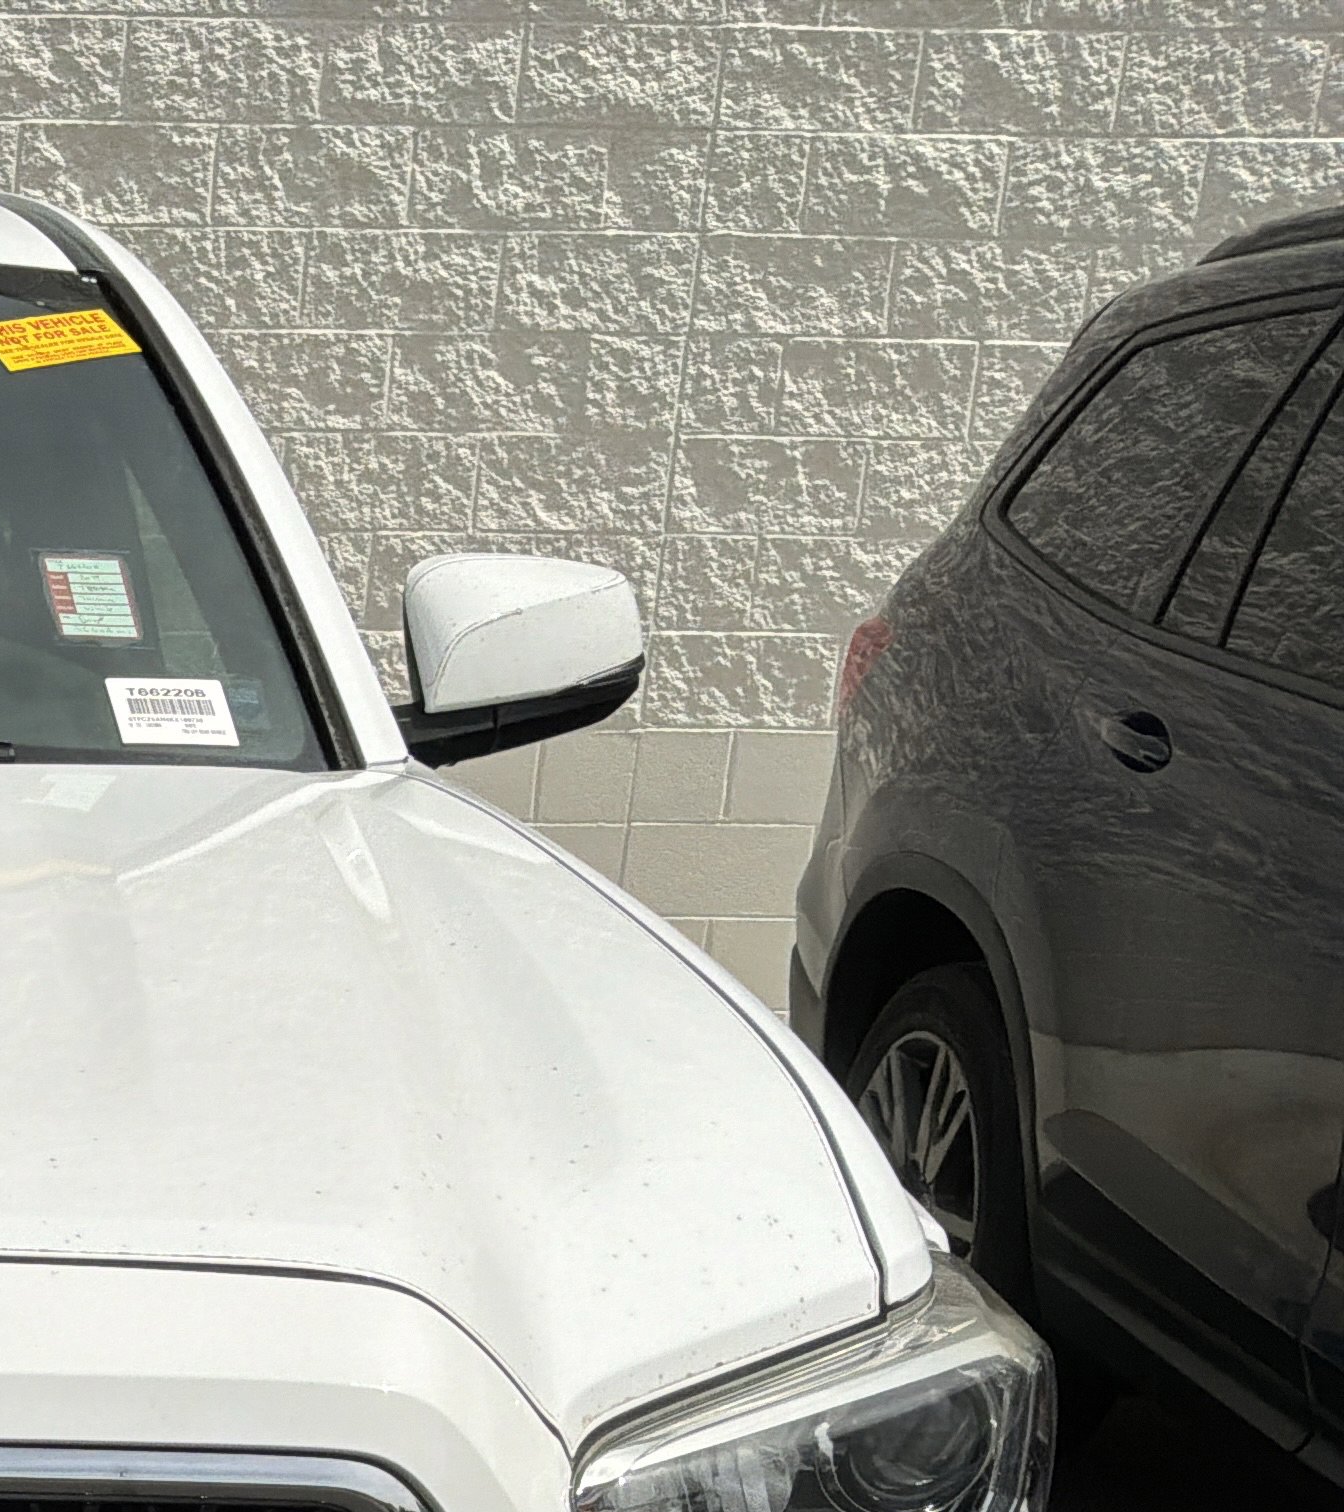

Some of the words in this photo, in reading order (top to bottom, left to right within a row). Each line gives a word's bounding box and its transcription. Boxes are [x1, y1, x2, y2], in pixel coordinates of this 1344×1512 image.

[27, 313, 106, 332] VEHICLE
[33, 331, 66, 342] FOR
[69, 324, 110, 336] SALE
